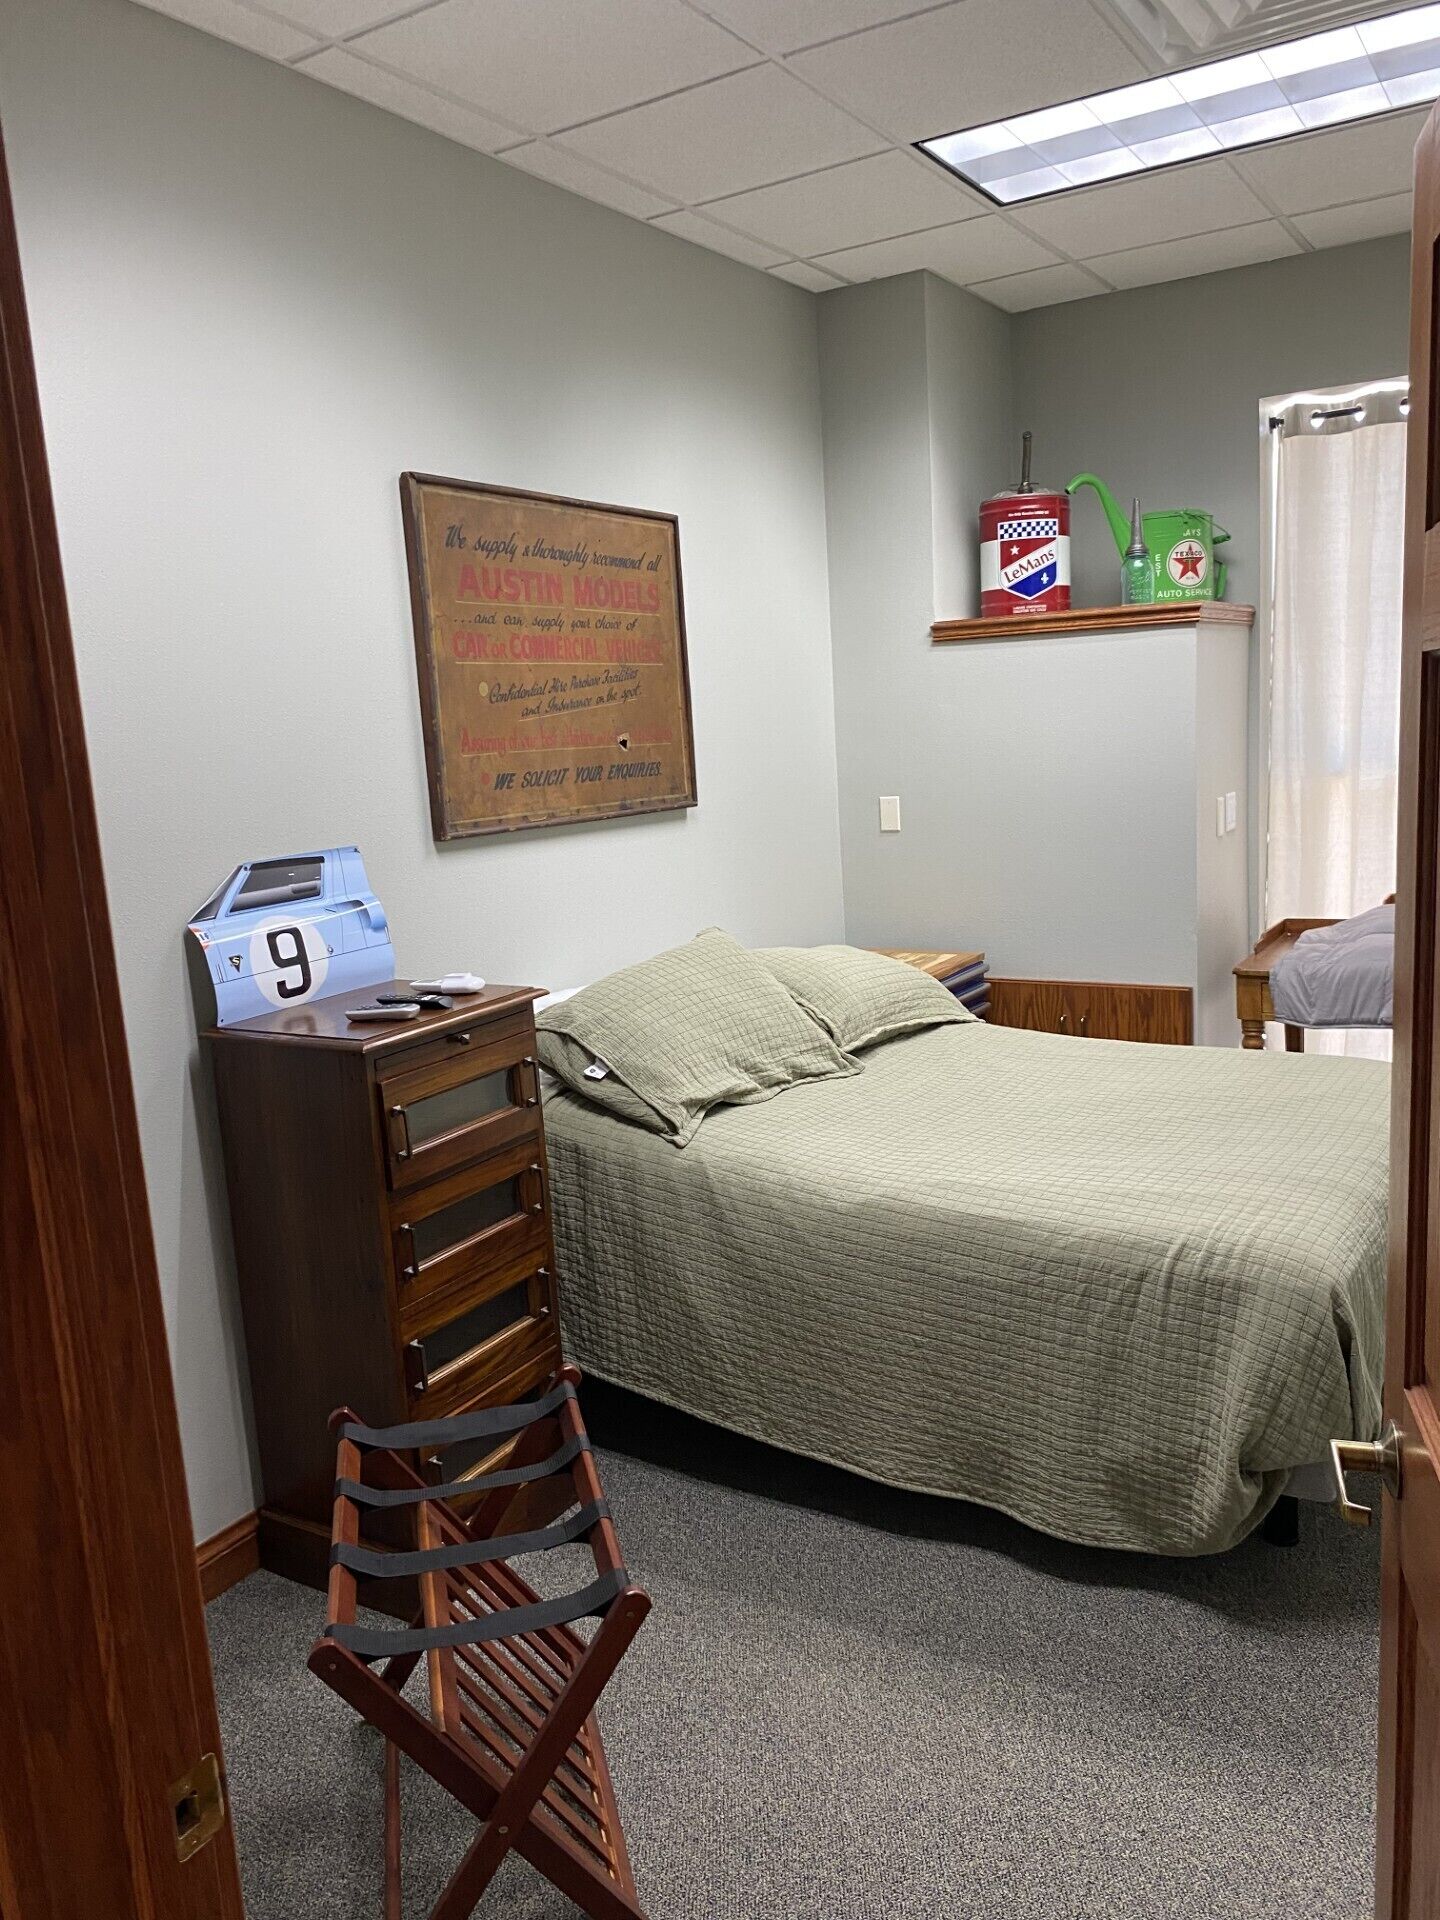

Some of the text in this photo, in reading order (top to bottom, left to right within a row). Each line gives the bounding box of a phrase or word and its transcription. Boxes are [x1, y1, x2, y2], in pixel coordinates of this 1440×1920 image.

[445, 523, 467, 550] We
[474, 531, 519, 563] supply
[532, 538, 590, 571] thoroughly
[592, 551, 647, 571] recommend
[646, 554, 663, 573] all
[1174, 550, 1203, 558] TEXACO
[1003, 548, 1056, 584] LeMans
[456, 563, 661, 613] AUSTIN MODELS
[1156, 589, 1182, 599] AUTO
[1185, 587, 1213, 598] SERVICE
[503, 614, 523, 626] can
[531, 613, 565, 632] supply
[571, 618, 592, 633] your
[595, 615, 622, 632] choice
[625, 618, 639, 632] of
[451, 629, 488, 660] CAR
[509, 632, 600, 661] COMMERCIAL
[488, 679, 549, 705] Confidential
[521, 700, 543, 718] and
[494, 771, 517, 792] WE
[520, 767, 570, 790] SOLICIT
[573, 763, 604, 785] YOUR
[266, 927, 312, 999] 9
